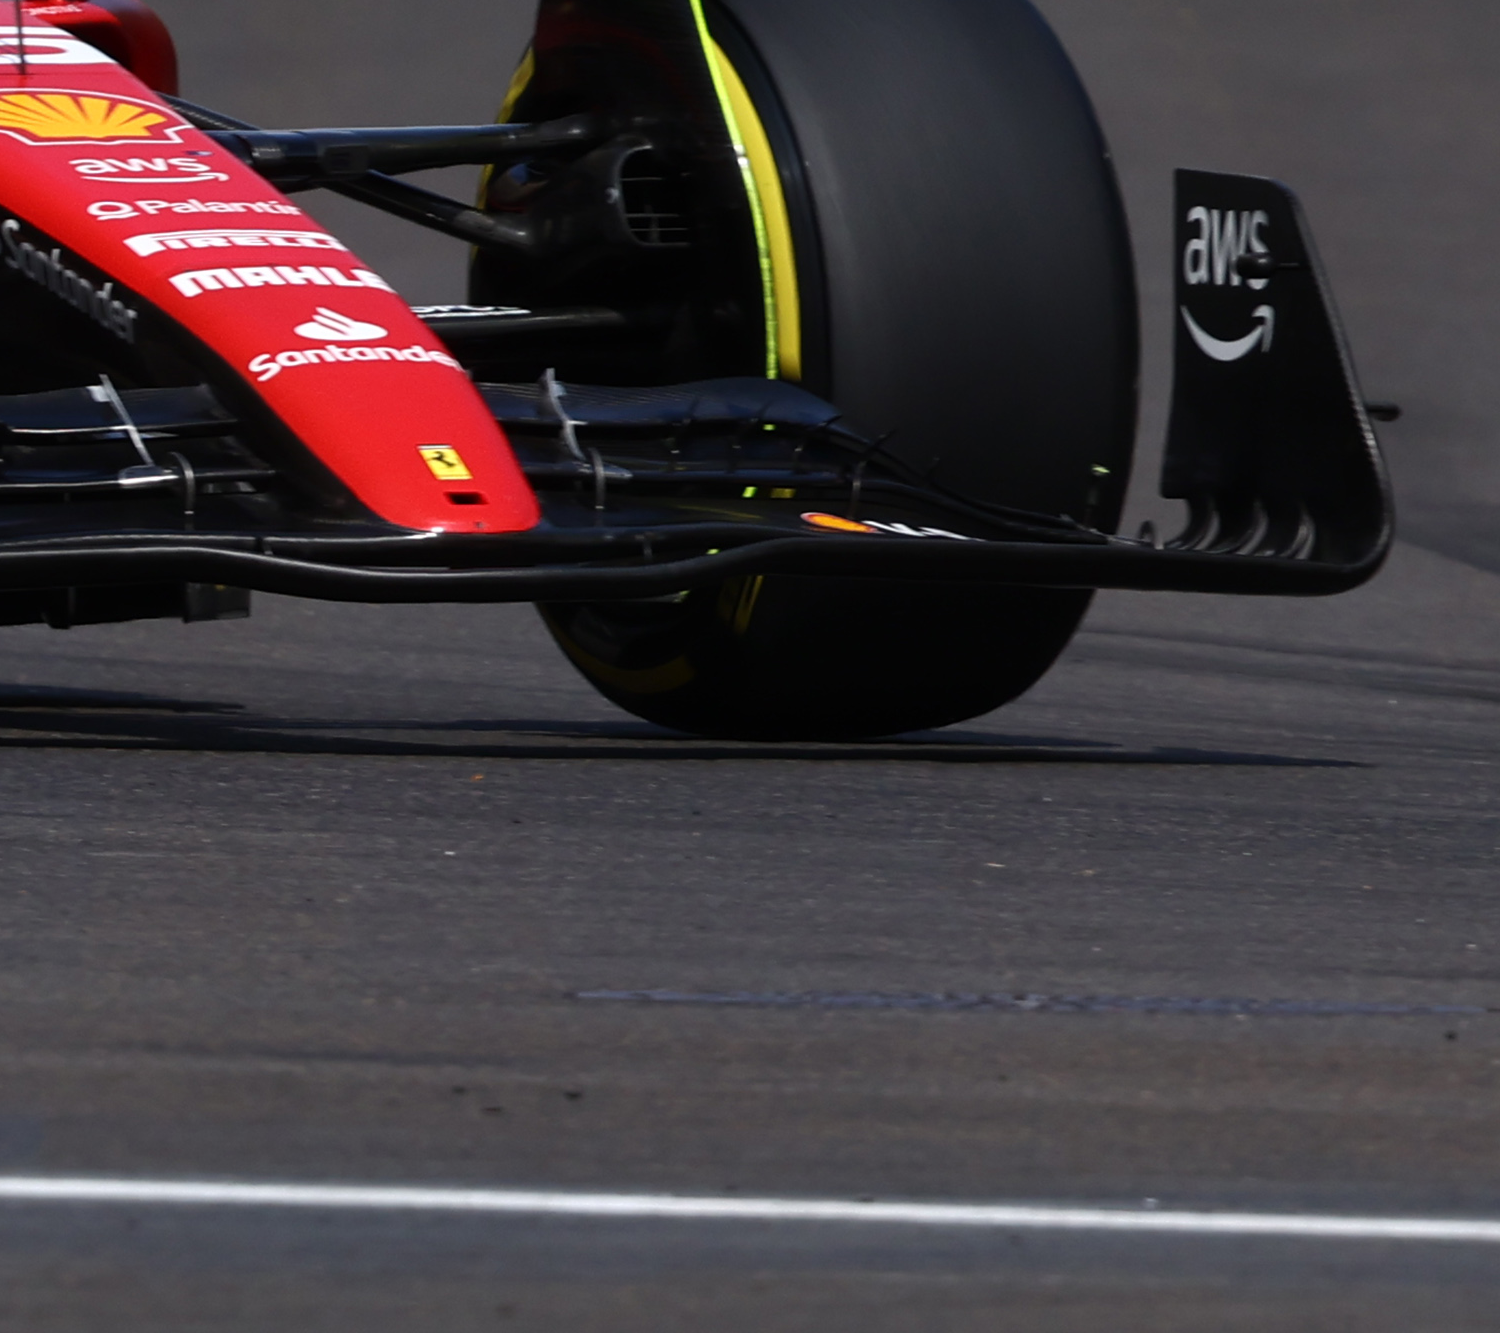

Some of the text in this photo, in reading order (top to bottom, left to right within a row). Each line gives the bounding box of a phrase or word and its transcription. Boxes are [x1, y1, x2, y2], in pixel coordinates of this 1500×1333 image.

[68, 157, 211, 174] aws
[1183, 205, 1270, 291] aws
[1, 218, 137, 345] Santander
[168, 266, 399, 298] MAHLE
